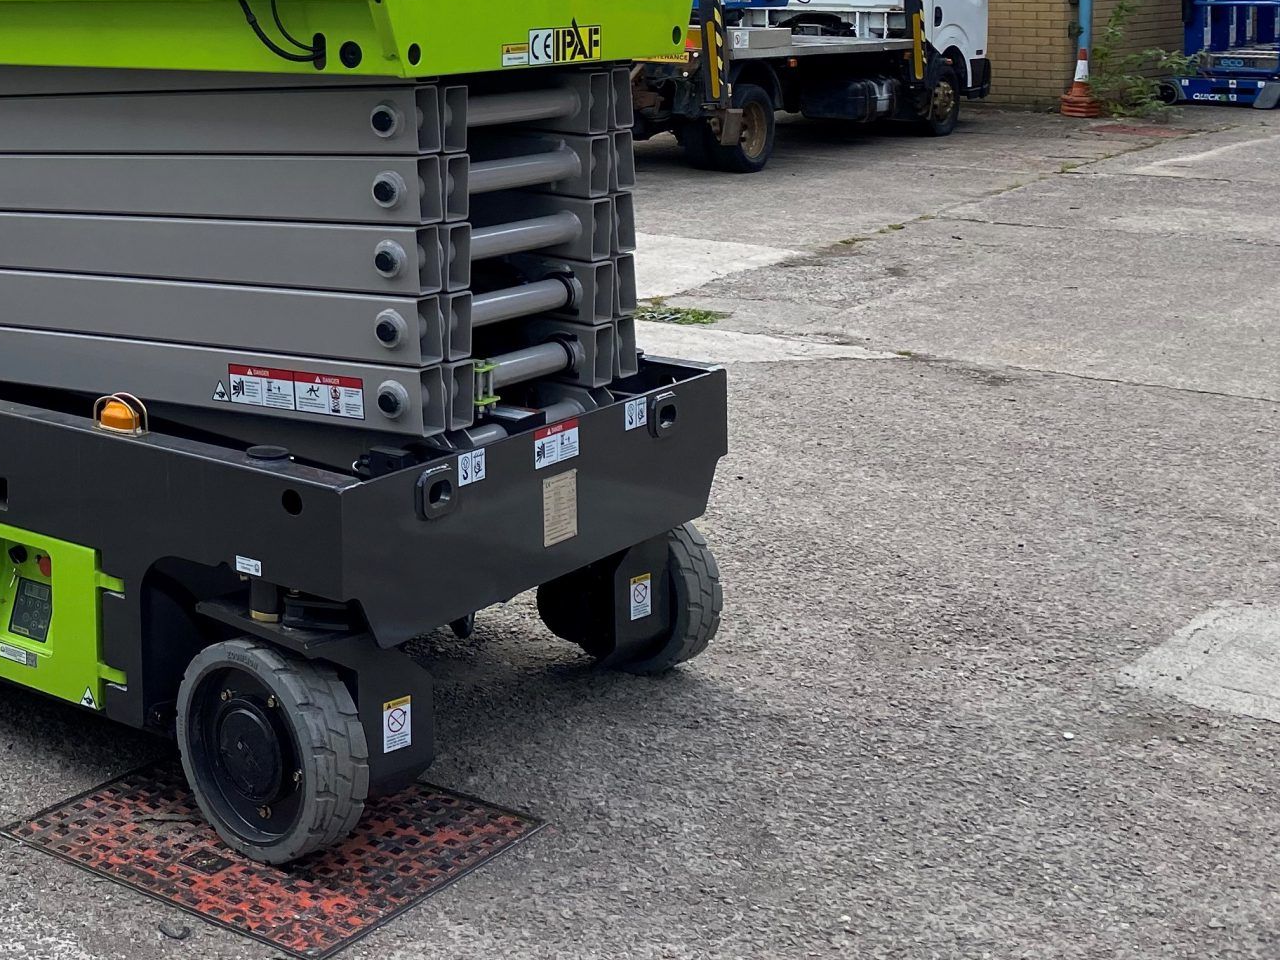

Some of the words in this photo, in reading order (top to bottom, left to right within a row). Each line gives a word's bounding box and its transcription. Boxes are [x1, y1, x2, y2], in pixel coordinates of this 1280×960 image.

[555, 17, 600, 62] IPAF
[253, 368, 270, 377] DANGER
[322, 376, 340, 385] DANGER
